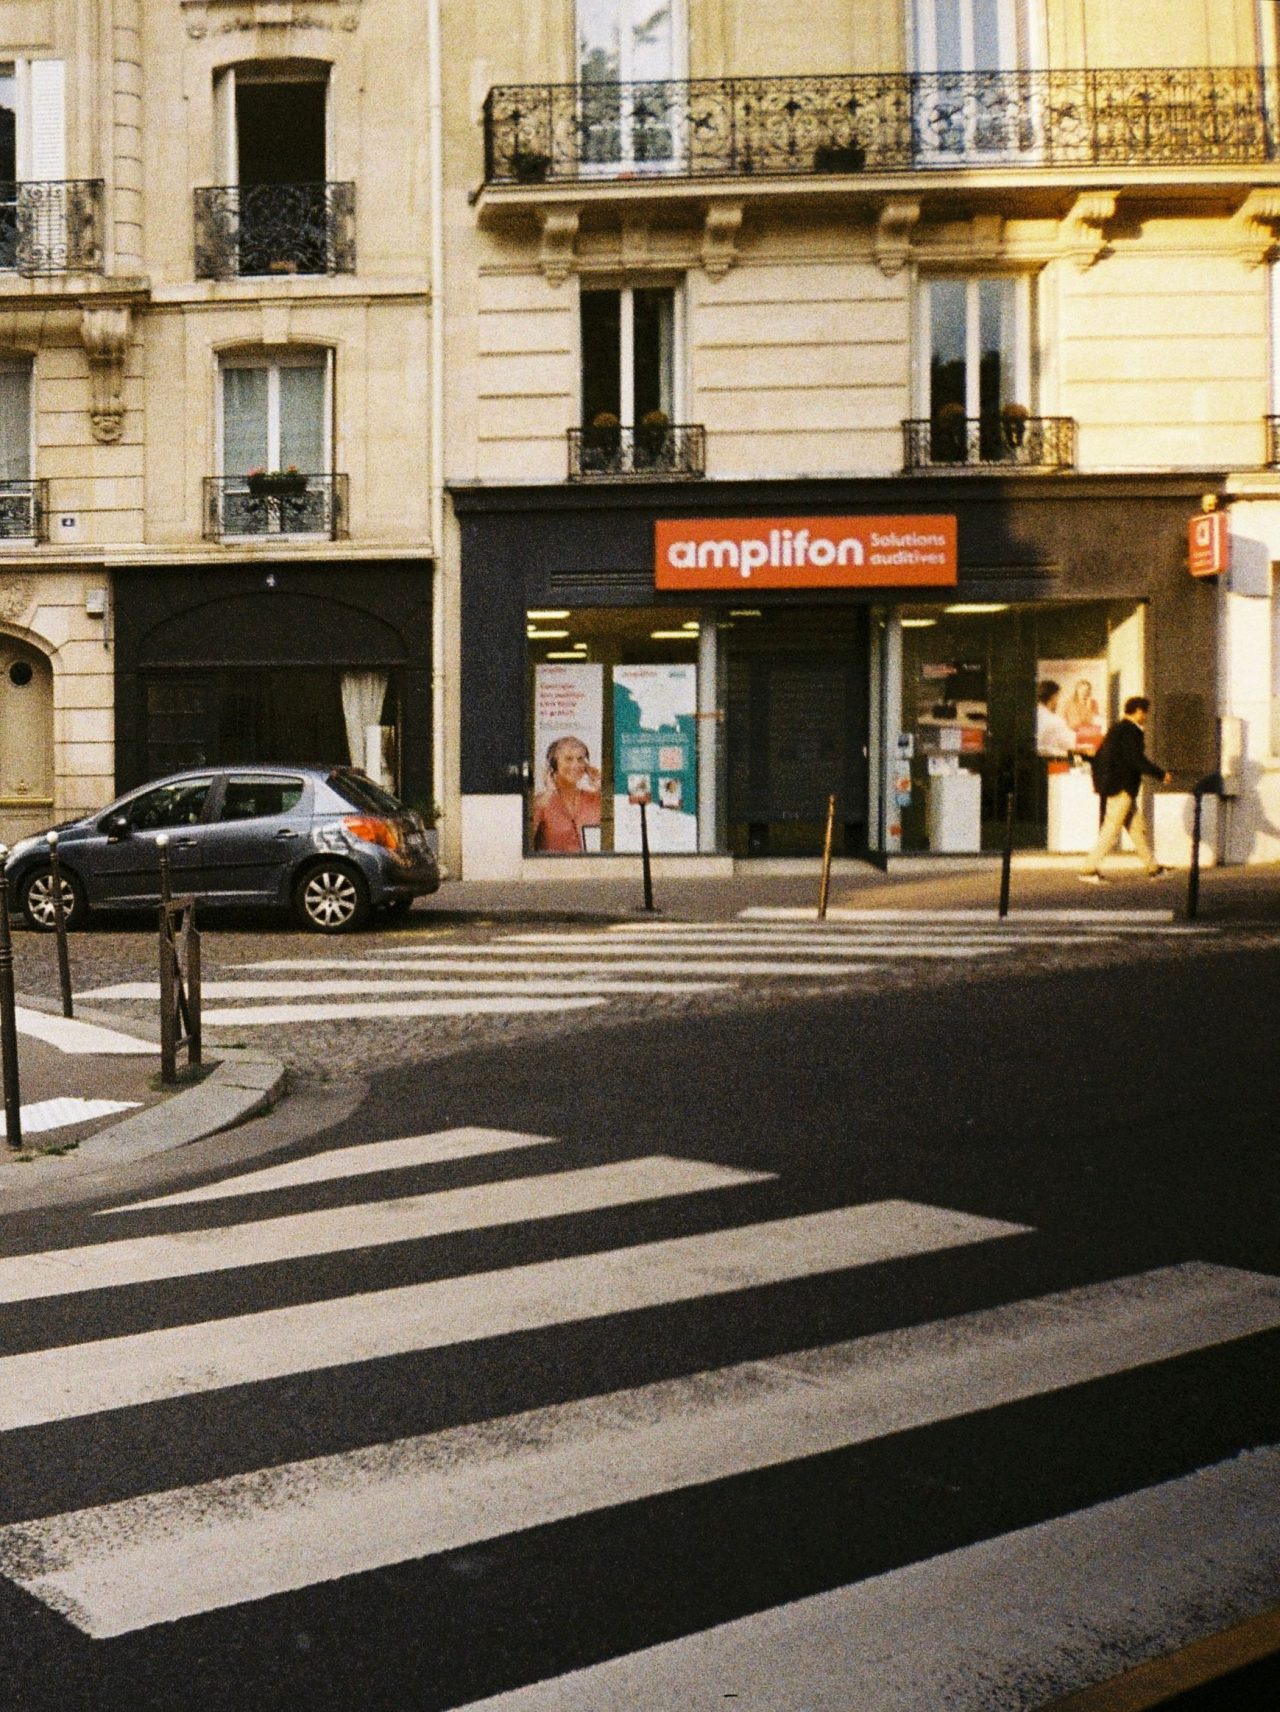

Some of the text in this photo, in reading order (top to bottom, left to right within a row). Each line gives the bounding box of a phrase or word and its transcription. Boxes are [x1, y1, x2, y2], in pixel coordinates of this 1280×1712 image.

[871, 532, 946, 547] Solutions
[668, 529, 864, 578] amplifon
[871, 550, 946, 565] auditives
